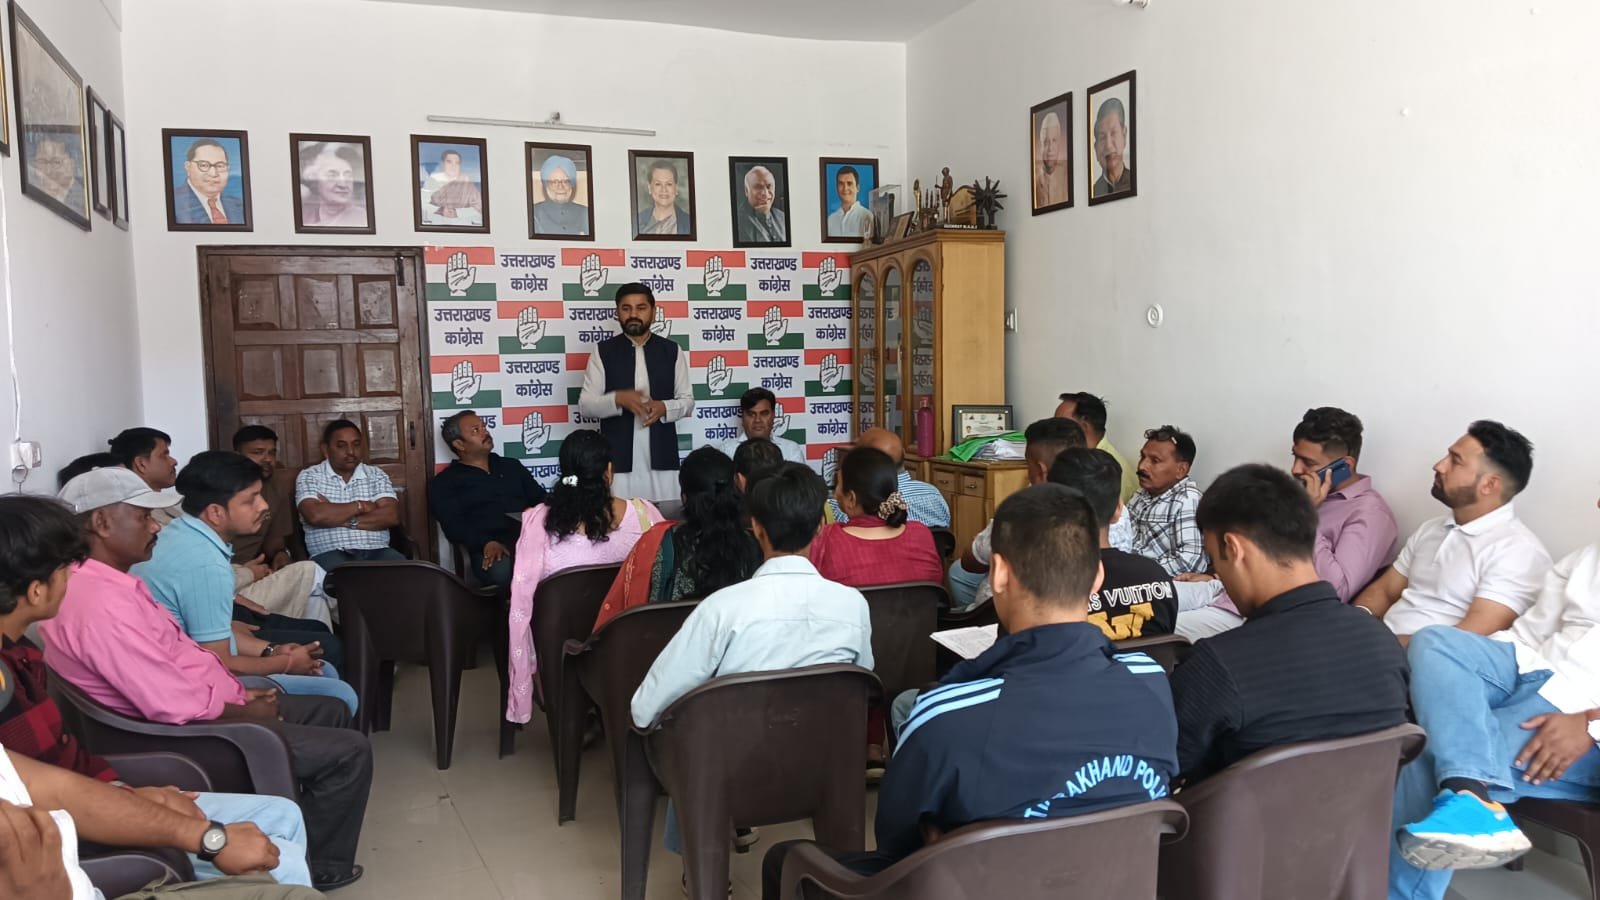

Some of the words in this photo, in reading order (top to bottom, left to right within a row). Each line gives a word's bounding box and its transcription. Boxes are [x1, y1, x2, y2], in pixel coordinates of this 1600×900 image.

[500, 254, 556, 269] उत्तराखण्ड
[630, 256, 682, 270] उत्तराखण्ड
[750, 257, 798, 271] उत्तराखण्ड
[510, 273, 548, 293] कांग्रेस
[758, 275, 791, 294] कांग्रेस
[433, 308, 492, 322] उत्तराखण्ड
[693, 307, 743, 320] उत्तराखण्ड
[807, 306, 853, 319] उत्तराखण्ड
[444, 327, 484, 347] कांग्रेस
[701, 324, 736, 344] कांग्रेस
[815, 323, 847, 342] कांग्रेस
[505, 360, 560, 374] उत्तराखण्ड
[752, 355, 801, 369] उत्तराखण्ड
[515, 378, 553, 399] कांग्रेस
[761, 373, 793, 391] कांग्रेस
[809, 402, 853, 415] उत्तराखण्ड
[704, 423, 738, 442] कांग्रेस
[817, 418, 848, 436] कांग्रेस
[1103, 581, 1173, 608] VUITTON
